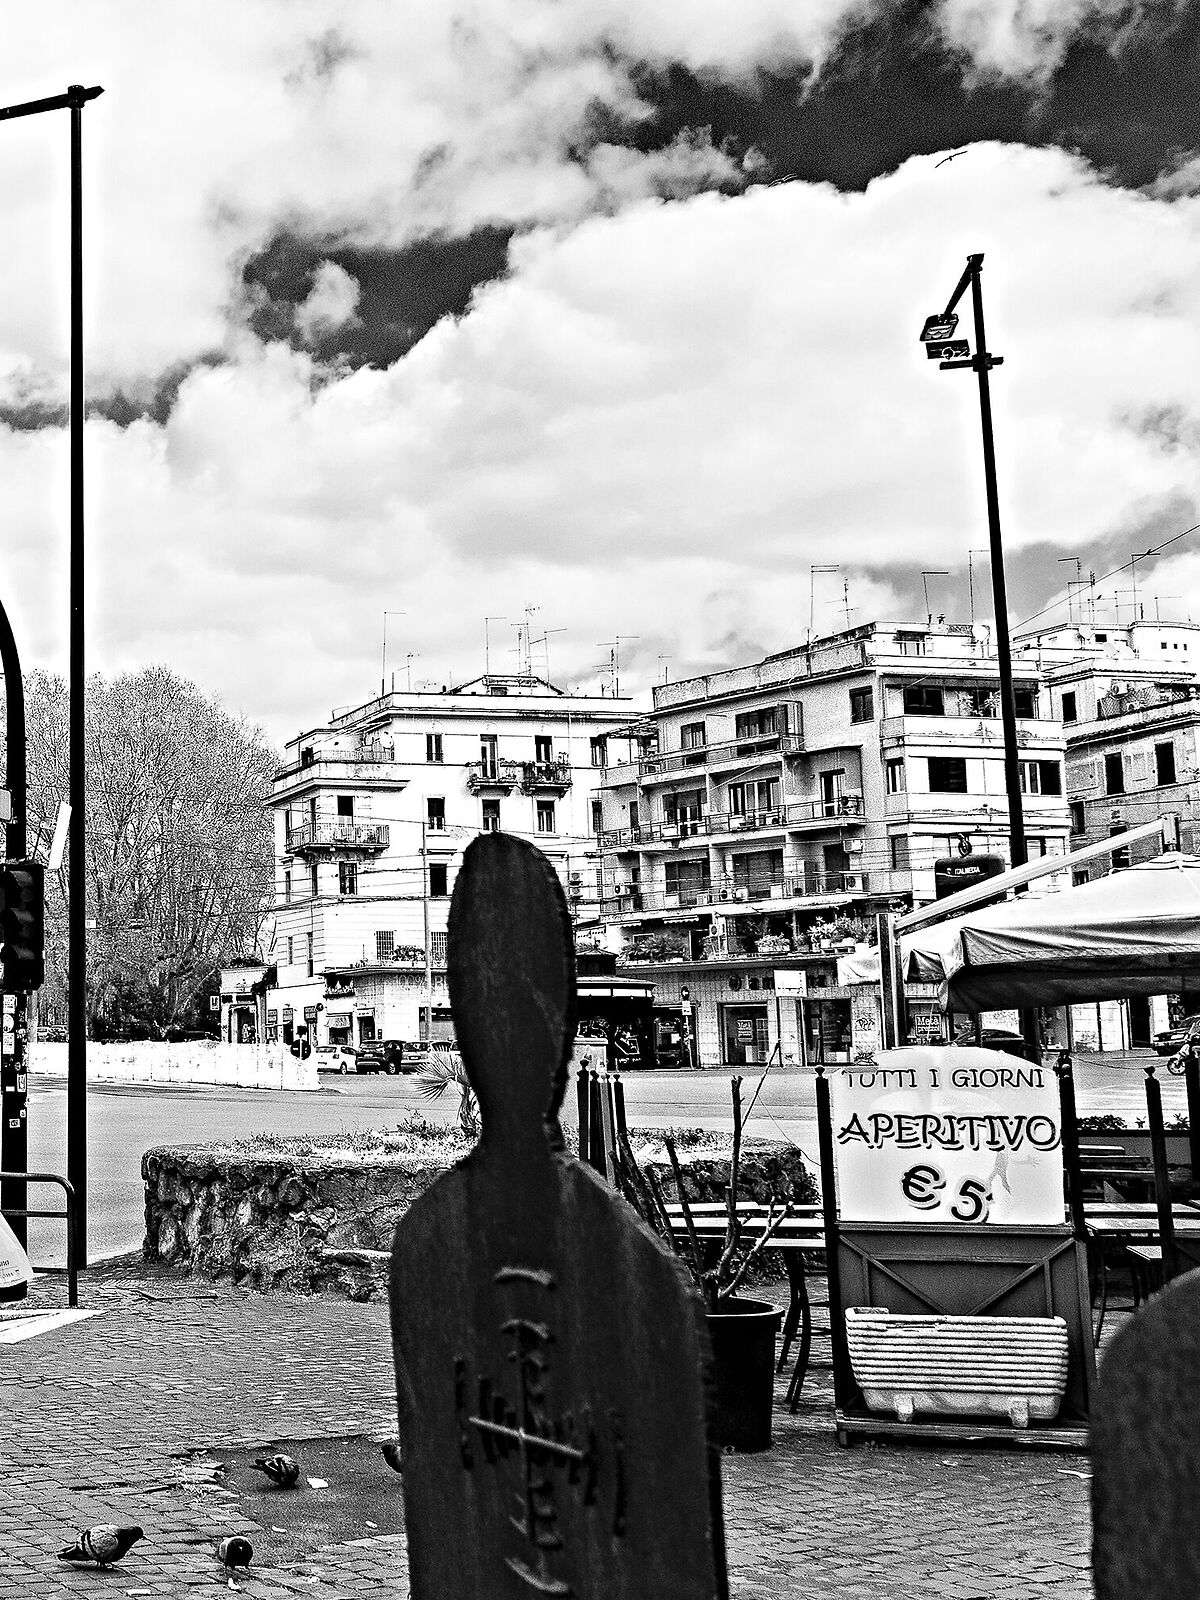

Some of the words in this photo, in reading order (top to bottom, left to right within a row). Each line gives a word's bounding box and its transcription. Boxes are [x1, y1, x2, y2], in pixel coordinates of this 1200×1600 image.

[841, 1068, 918, 1088] TUTTI
[929, 1068, 940, 1088] I
[951, 1068, 1046, 1088] GIORNI
[837, 1112, 1062, 1151] APERITIVO
